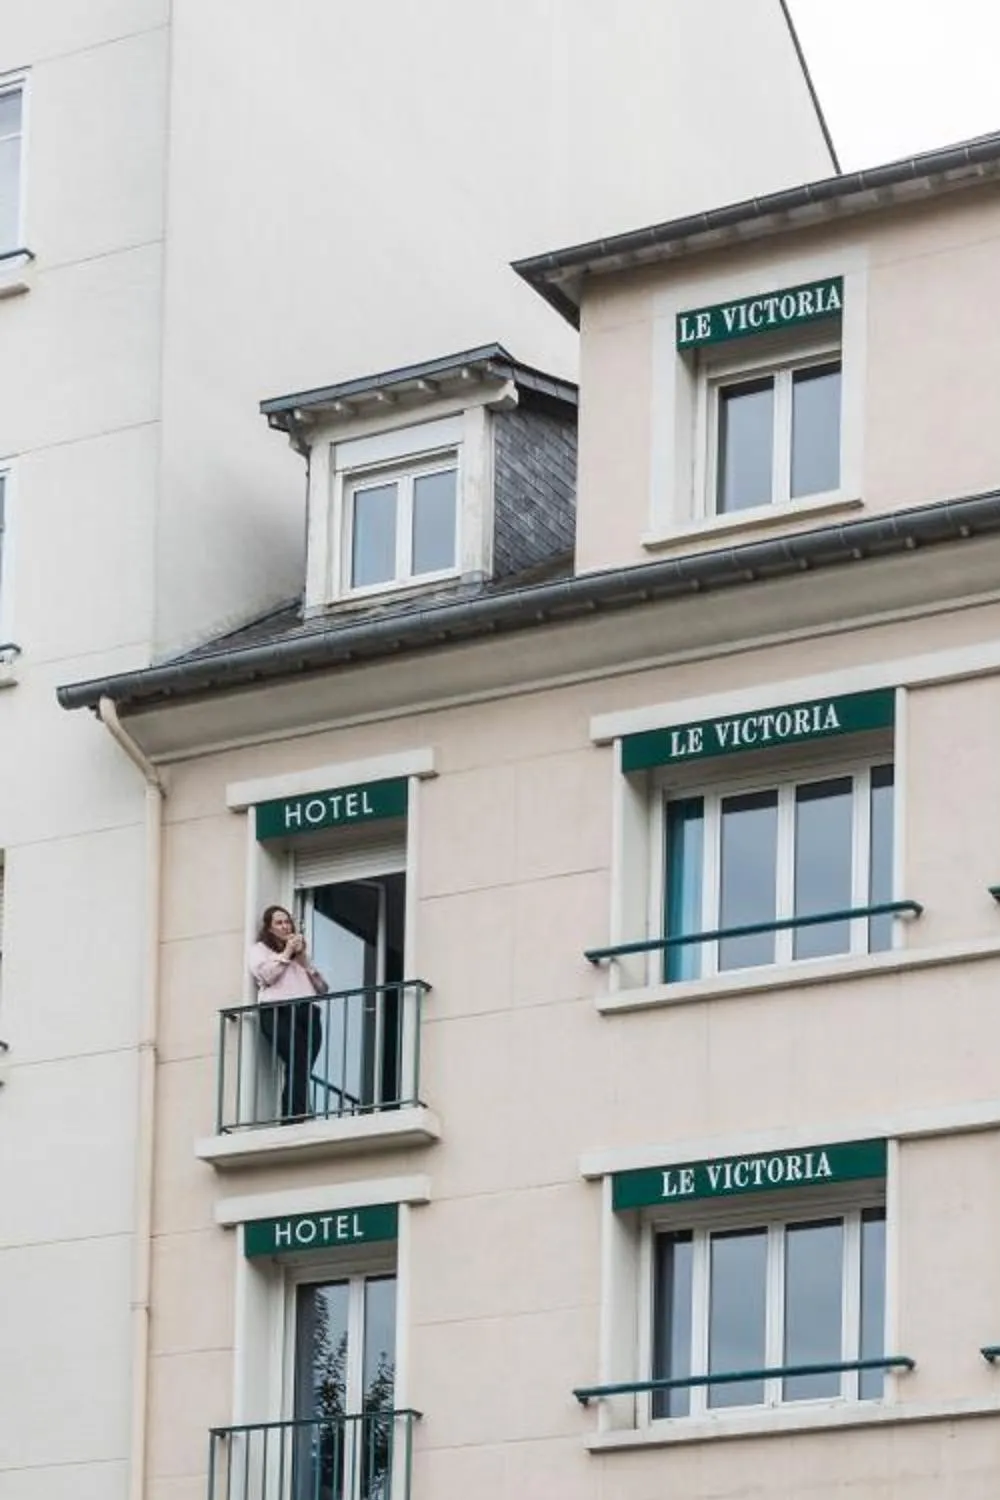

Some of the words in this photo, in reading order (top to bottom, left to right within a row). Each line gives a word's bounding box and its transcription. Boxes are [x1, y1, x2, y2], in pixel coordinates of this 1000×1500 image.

[679, 312, 711, 345] LE
[720, 284, 843, 331] VICTORIA
[670, 727, 704, 758] LE
[715, 703, 840, 748] VICTORIA
[284, 791, 374, 828] HOTEL
[661, 1168, 695, 1197] LE
[706, 1151, 833, 1190] VICTORIA
[274, 1214, 364, 1245] HOTEL
